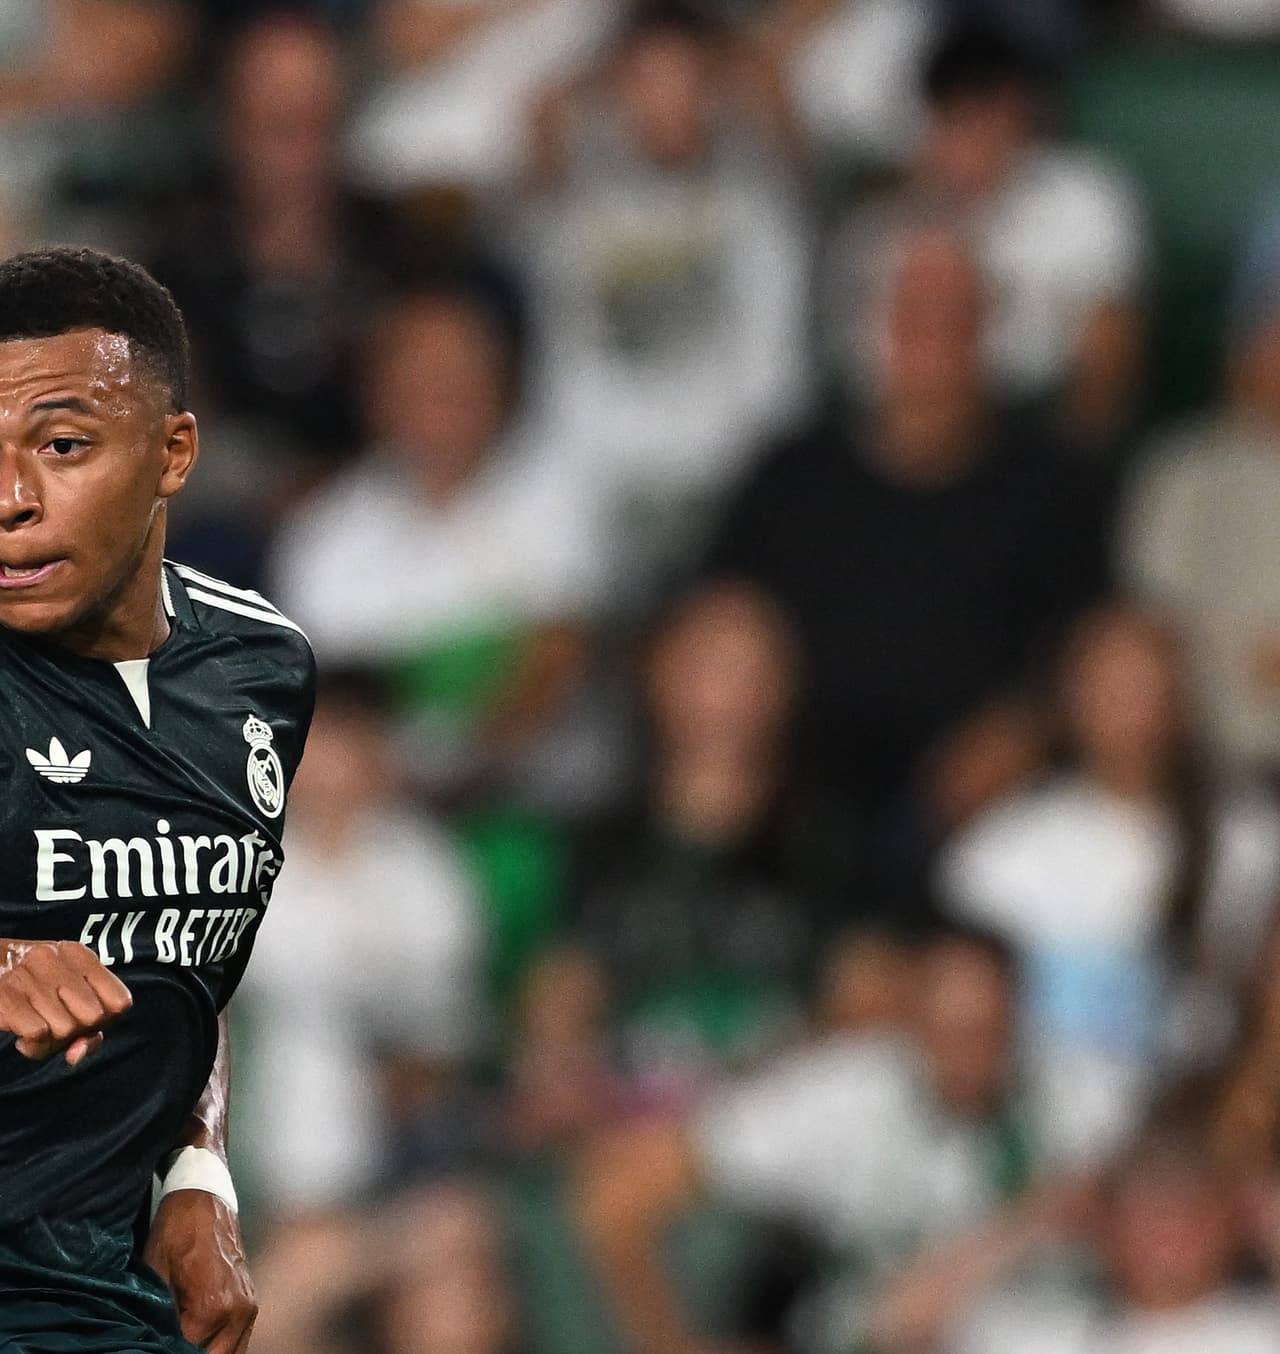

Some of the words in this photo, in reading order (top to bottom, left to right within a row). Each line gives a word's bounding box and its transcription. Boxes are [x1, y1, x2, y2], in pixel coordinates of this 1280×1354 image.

[33, 819, 282, 905] Emirate
[80, 911, 147, 966] FLY
[154, 908, 258, 967] BETTER
